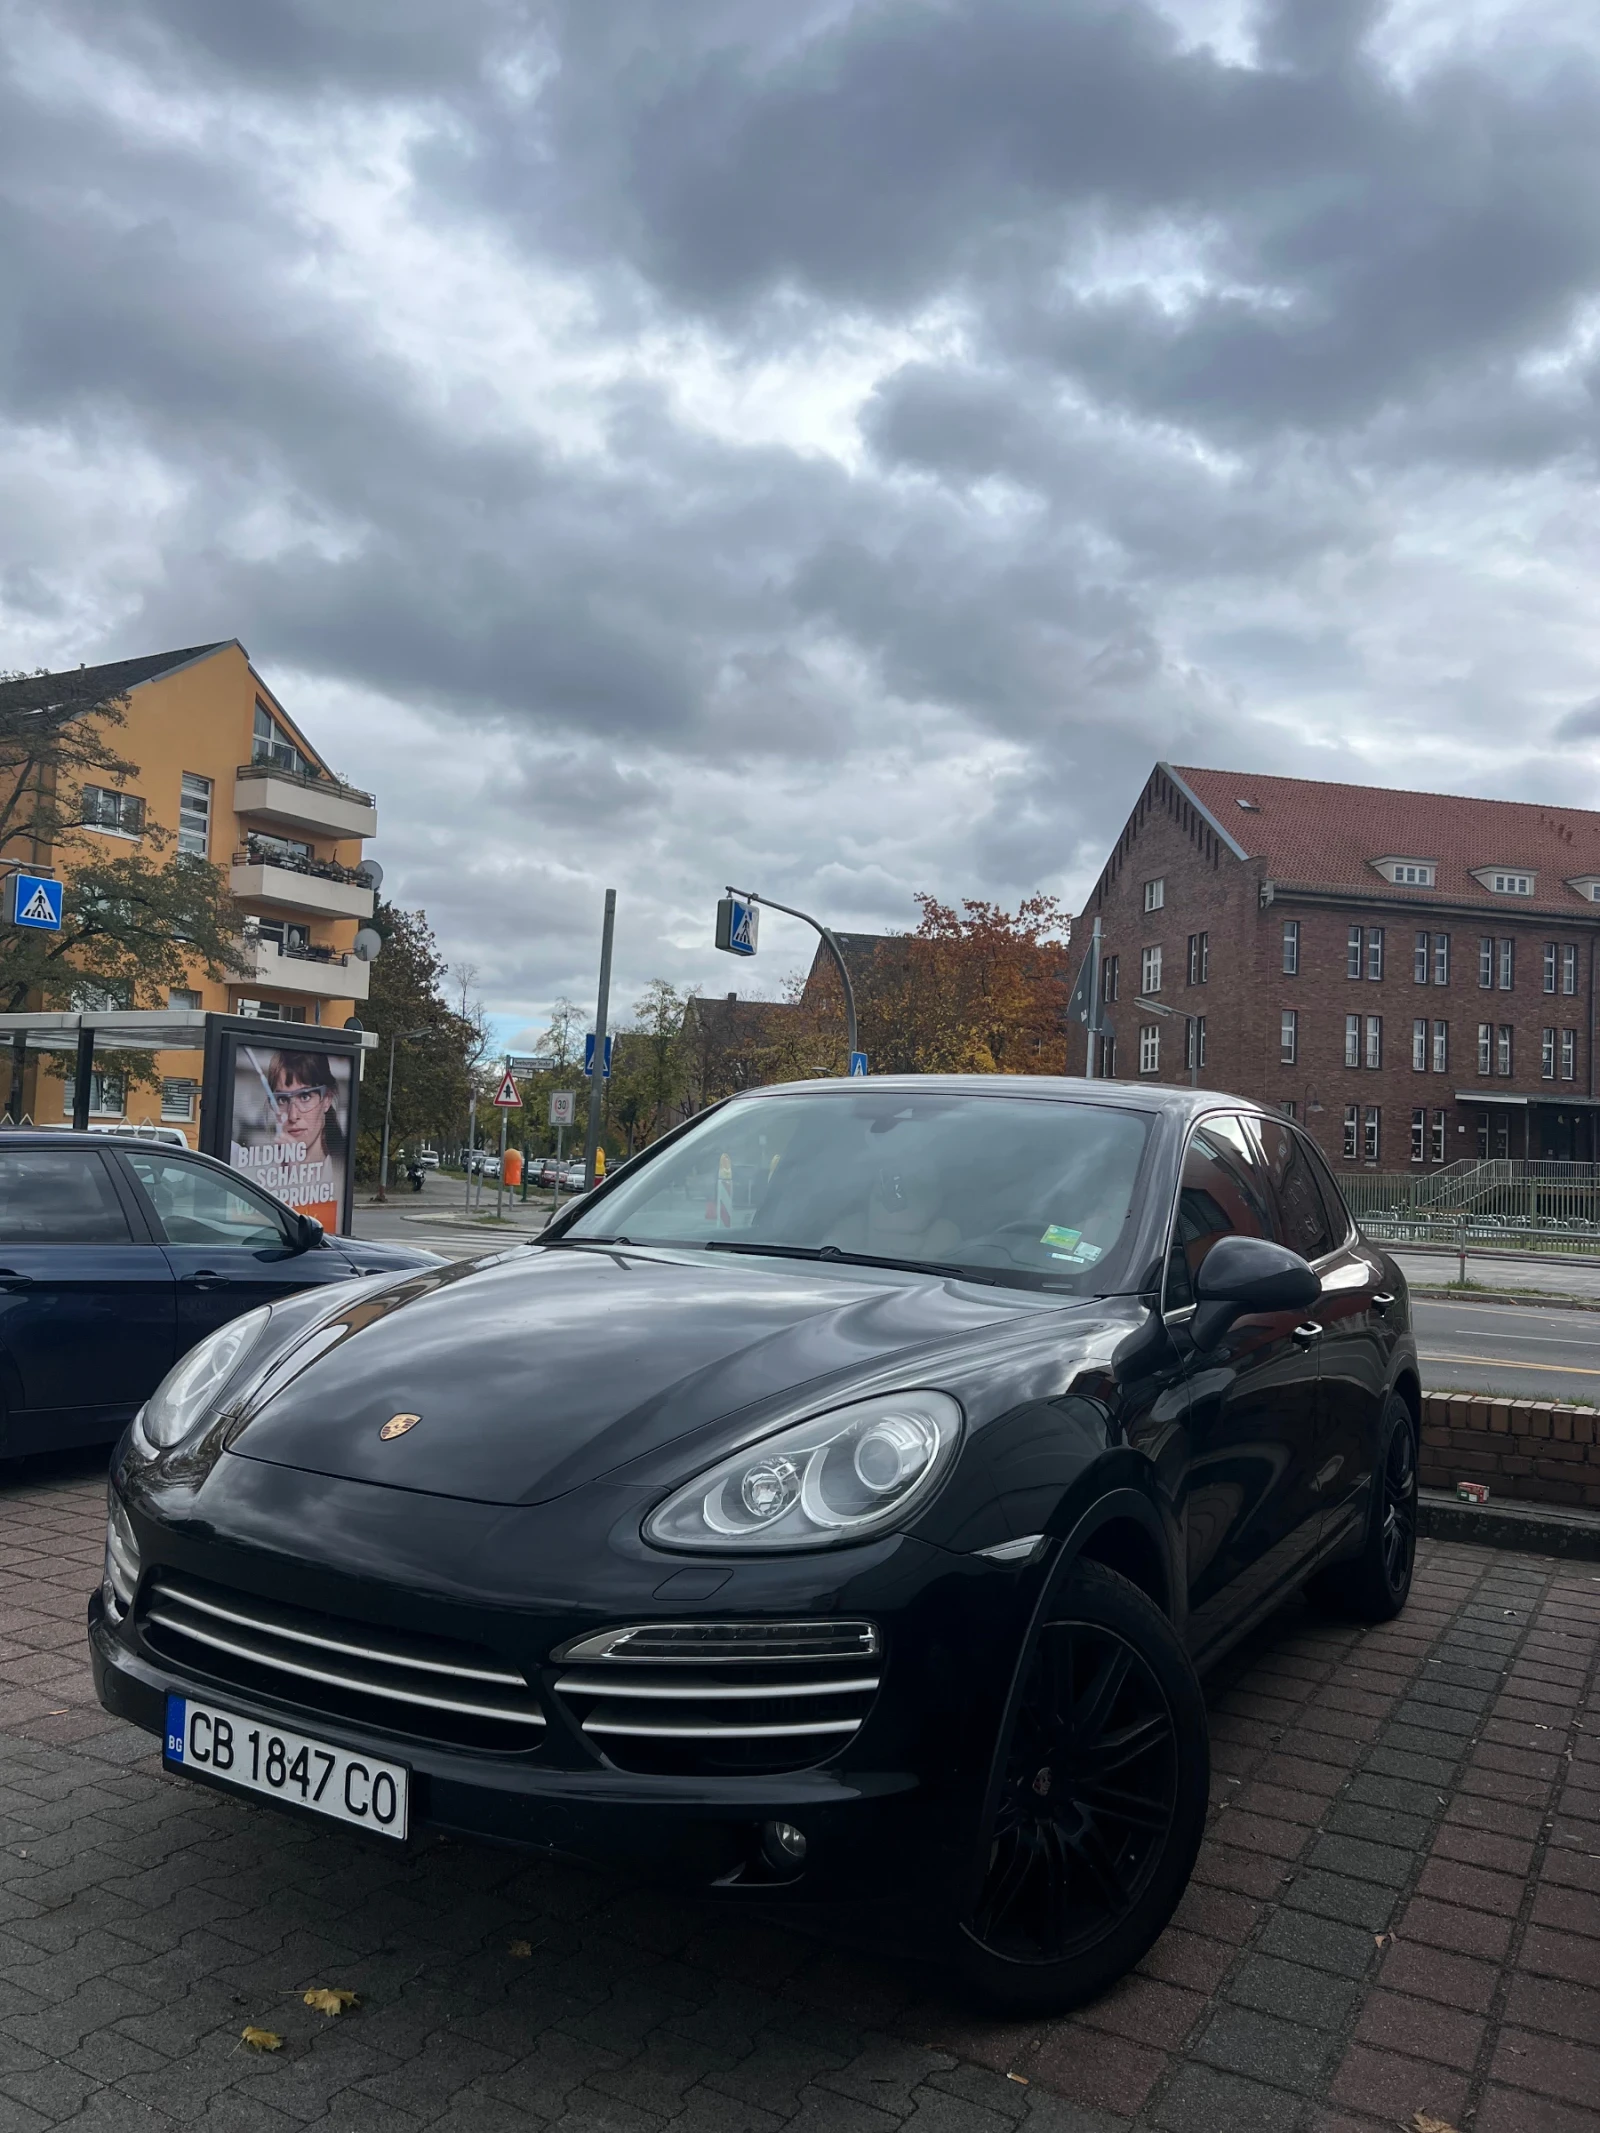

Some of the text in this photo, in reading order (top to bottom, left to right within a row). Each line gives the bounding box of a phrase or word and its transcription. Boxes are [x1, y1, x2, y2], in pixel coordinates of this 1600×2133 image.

[557, 1099, 566, 1110] 30
[238, 1141, 307, 1168] BILDUNG
[256, 1162, 323, 1188] SCHAFFT
[167, 1734, 183, 1753] BG
[189, 1711, 397, 1824] CB 1847 CO
